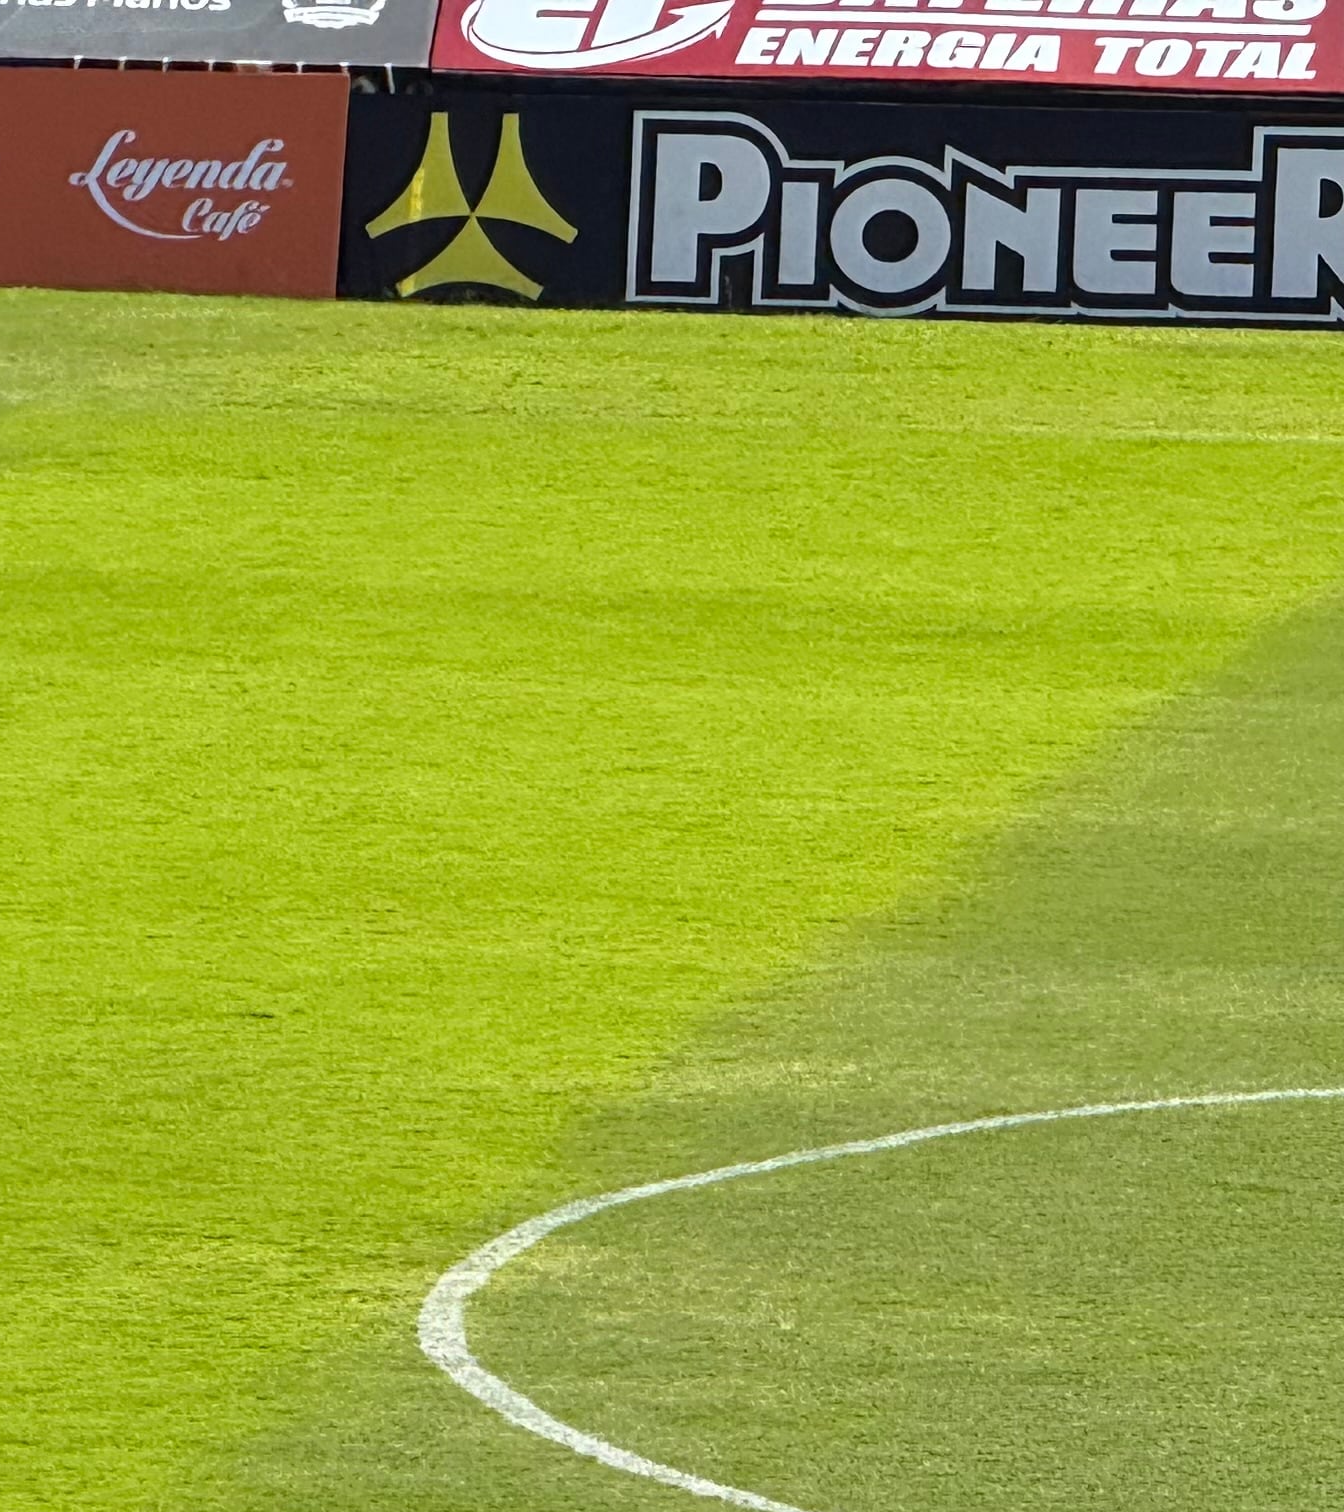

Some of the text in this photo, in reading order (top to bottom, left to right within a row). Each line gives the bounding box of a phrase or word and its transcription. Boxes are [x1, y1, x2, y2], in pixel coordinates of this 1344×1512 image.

[734, 27, 1316, 80] ENERGIA TOTAL
[68, 129, 288, 239] Leyenda
[182, 198, 271, 241] Café
[650, 131, 1344, 299] PIONEER
